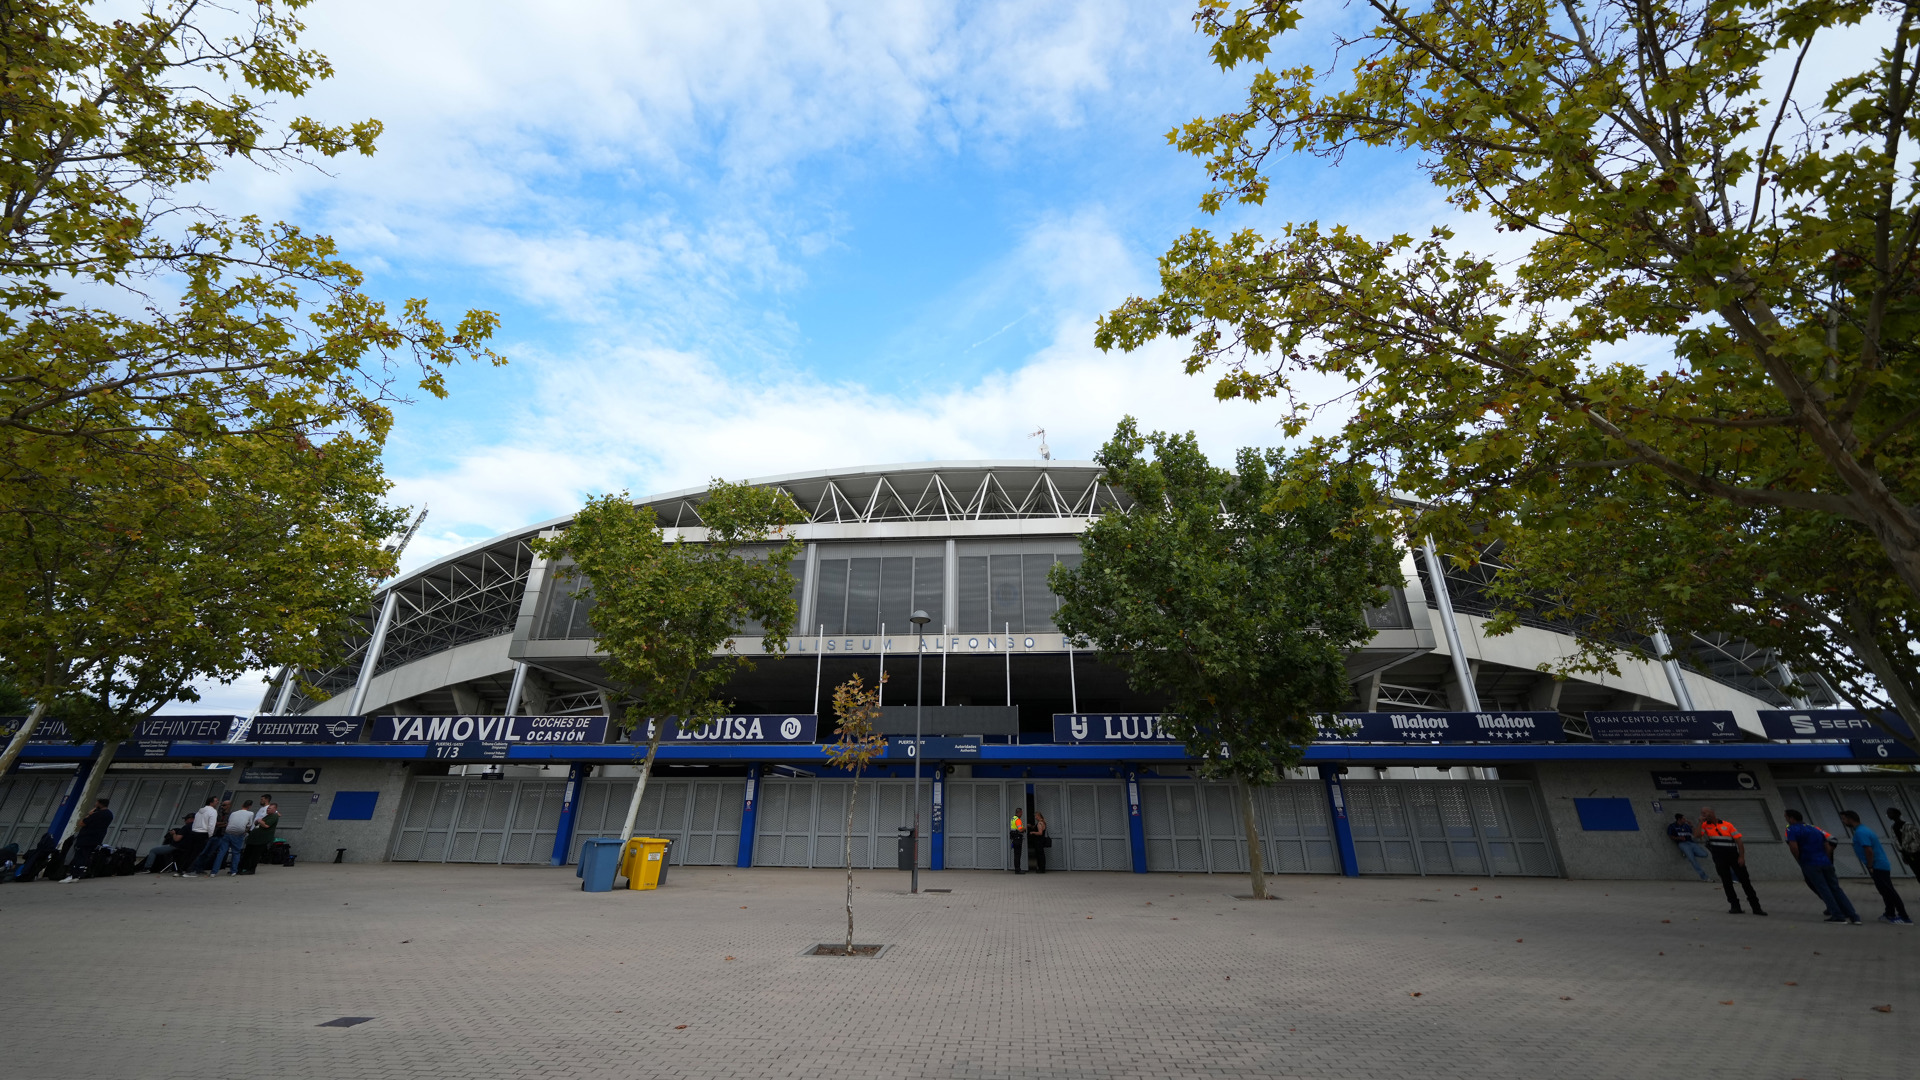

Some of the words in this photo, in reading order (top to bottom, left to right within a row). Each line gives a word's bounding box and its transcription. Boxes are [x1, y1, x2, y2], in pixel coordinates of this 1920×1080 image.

[918, 637, 1035, 650] ALFONSO
[531, 717, 577, 728] COCHES
[577, 717, 591, 728] DE
[1390, 714, 1450, 729] Mahou
[1475, 713, 1536, 729] Mahou
[1593, 716, 1620, 724] GRAN
[1662, 715, 1698, 723] GETAFE
[1818, 719, 1872, 729] SEAT
[141, 720, 221, 736] VEHINTER
[256, 723, 320, 735] VEHINTER
[392, 717, 521, 741] YAMOVIL
[676, 717, 764, 740] LUJISA
[526, 729, 586, 741] OCASIÓN
[907, 745, 916, 757] 0
[1876, 744, 1888, 758] 6
[570, 769, 576, 779] 3
[935, 770, 941, 780] 0
[1129, 771, 1136, 782] 2
[1331, 772, 1338, 783] 4
